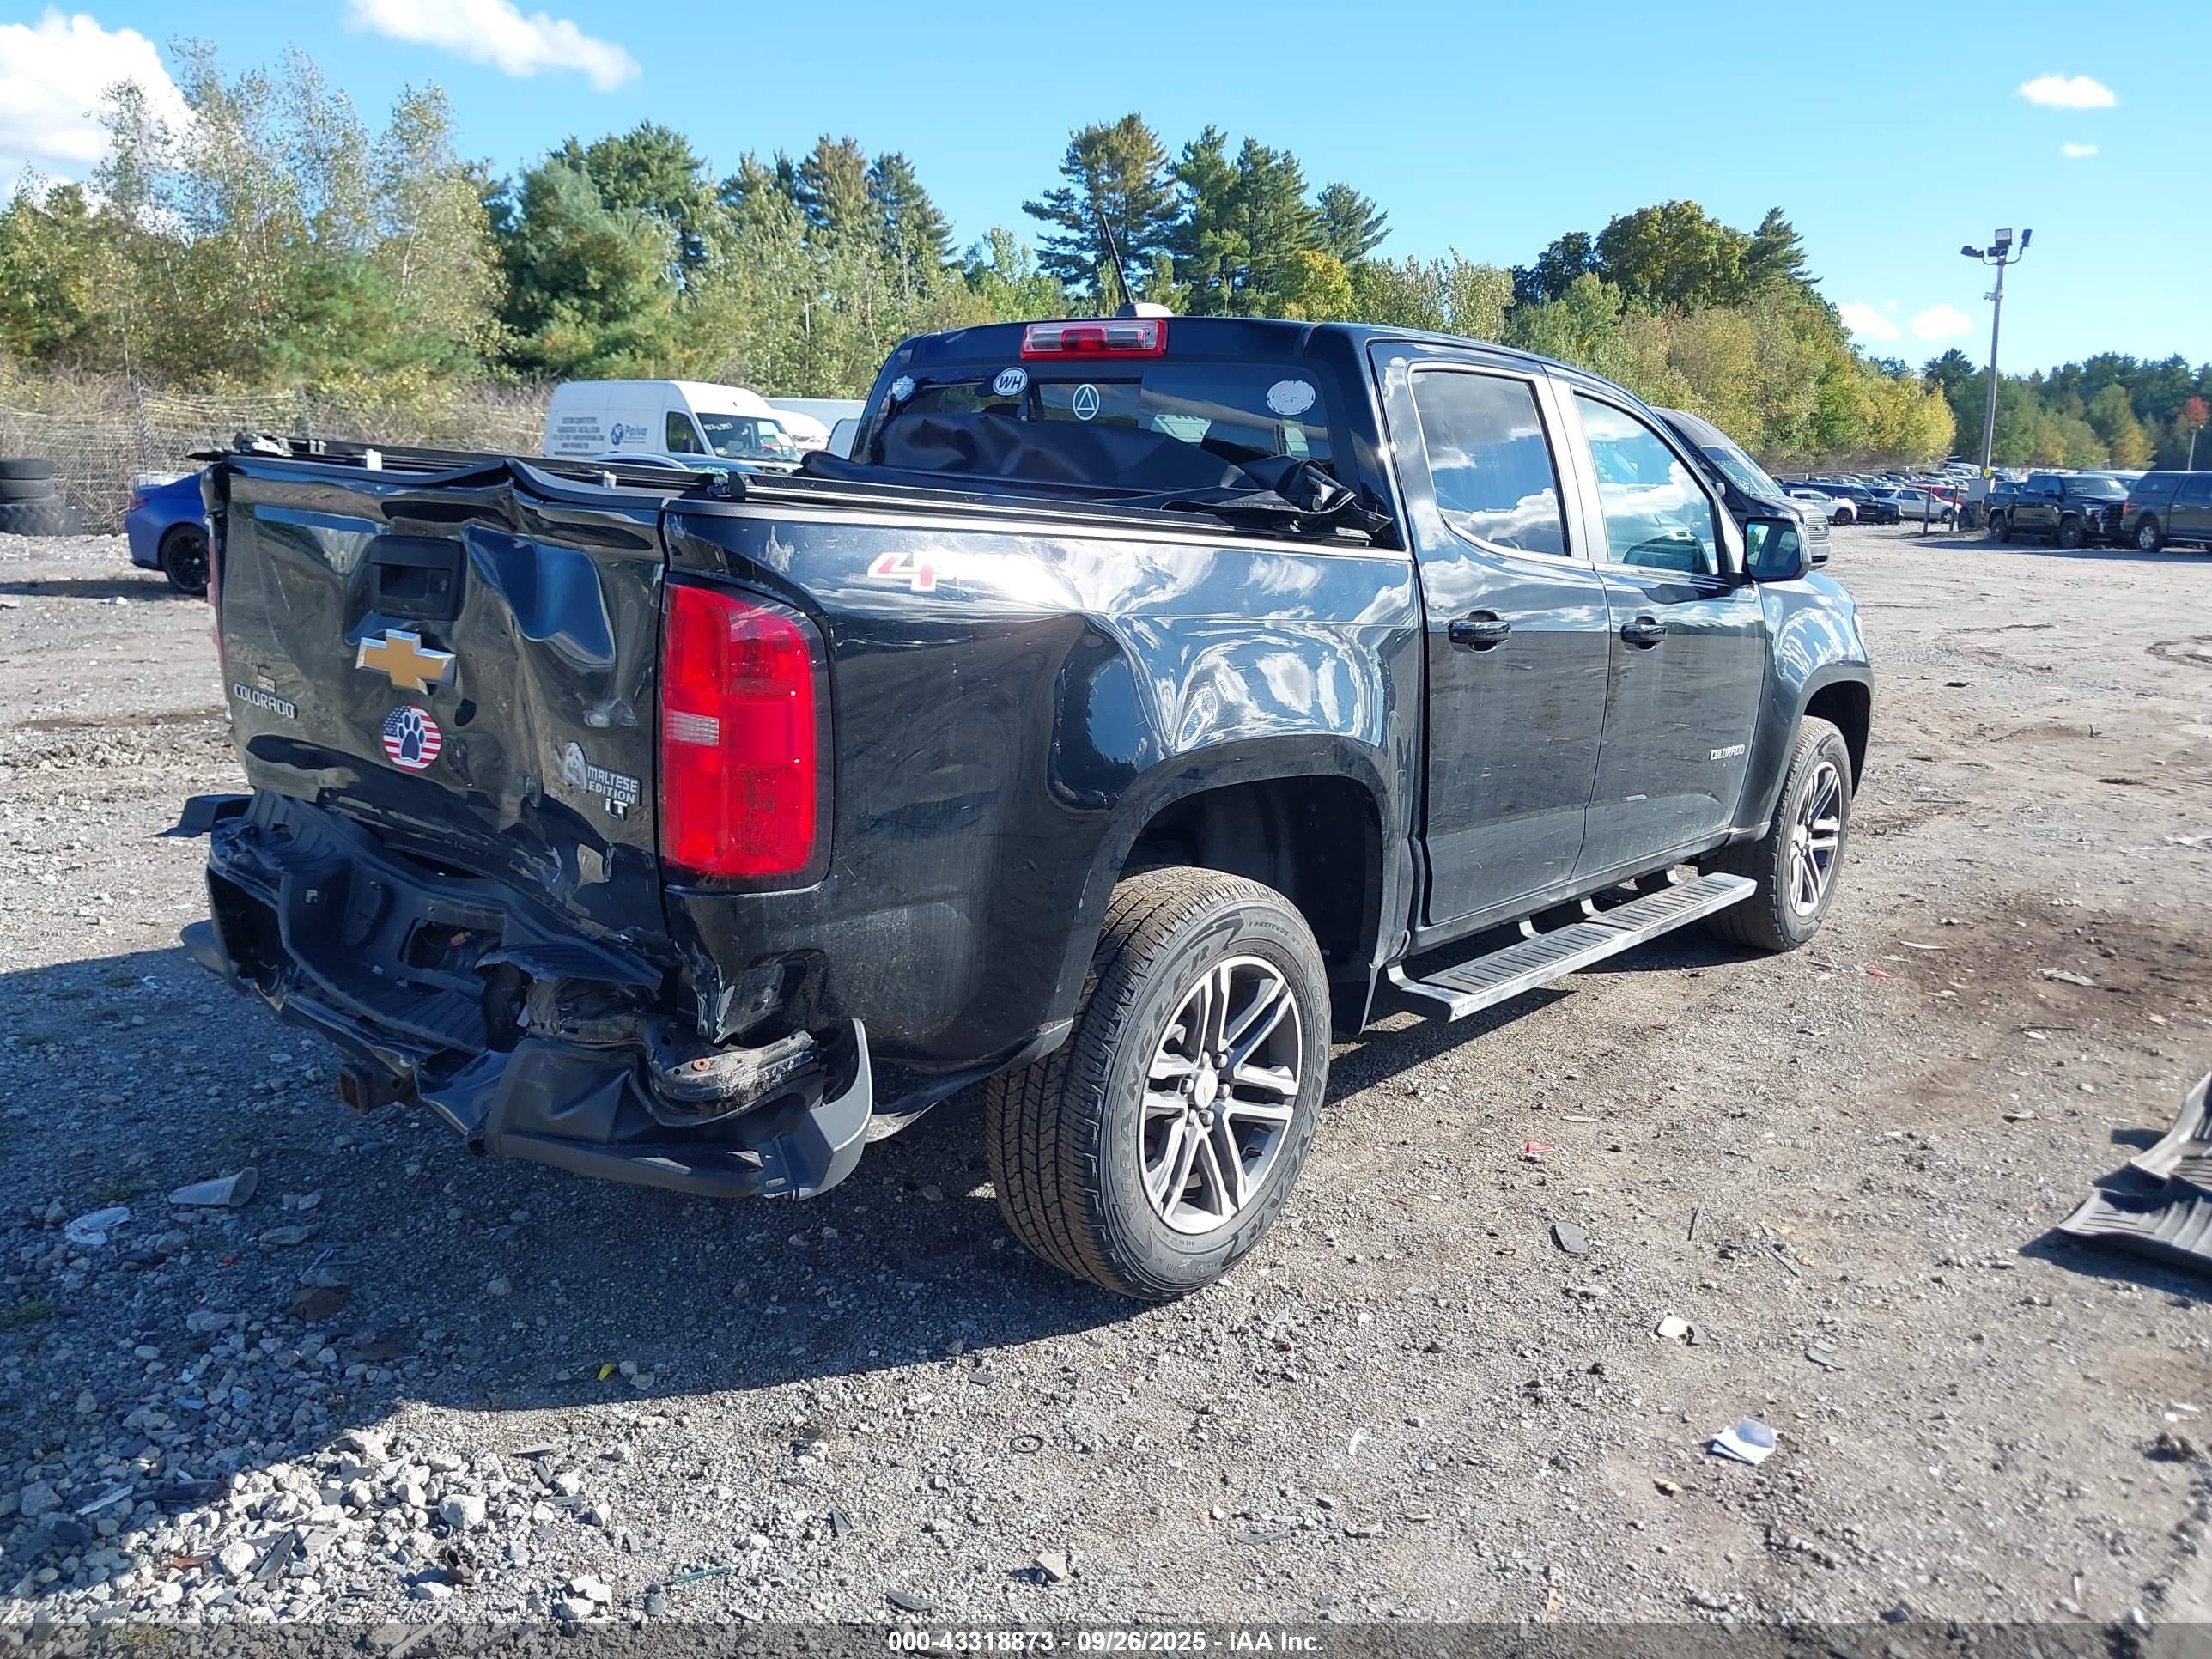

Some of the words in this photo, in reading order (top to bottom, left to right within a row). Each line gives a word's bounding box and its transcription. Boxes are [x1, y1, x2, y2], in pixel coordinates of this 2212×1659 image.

[999, 375, 1023, 389] WH
[234, 683, 296, 720] COLORADO
[1709, 744, 1746, 761] COLORADO
[586, 765, 639, 793] MALTESE
[587, 780, 636, 805] EDITION
[605, 797, 629, 821] LT
[1119, 945, 1211, 1221] WRANGLER
[1248, 984, 1326, 1239] GOODYEAR
